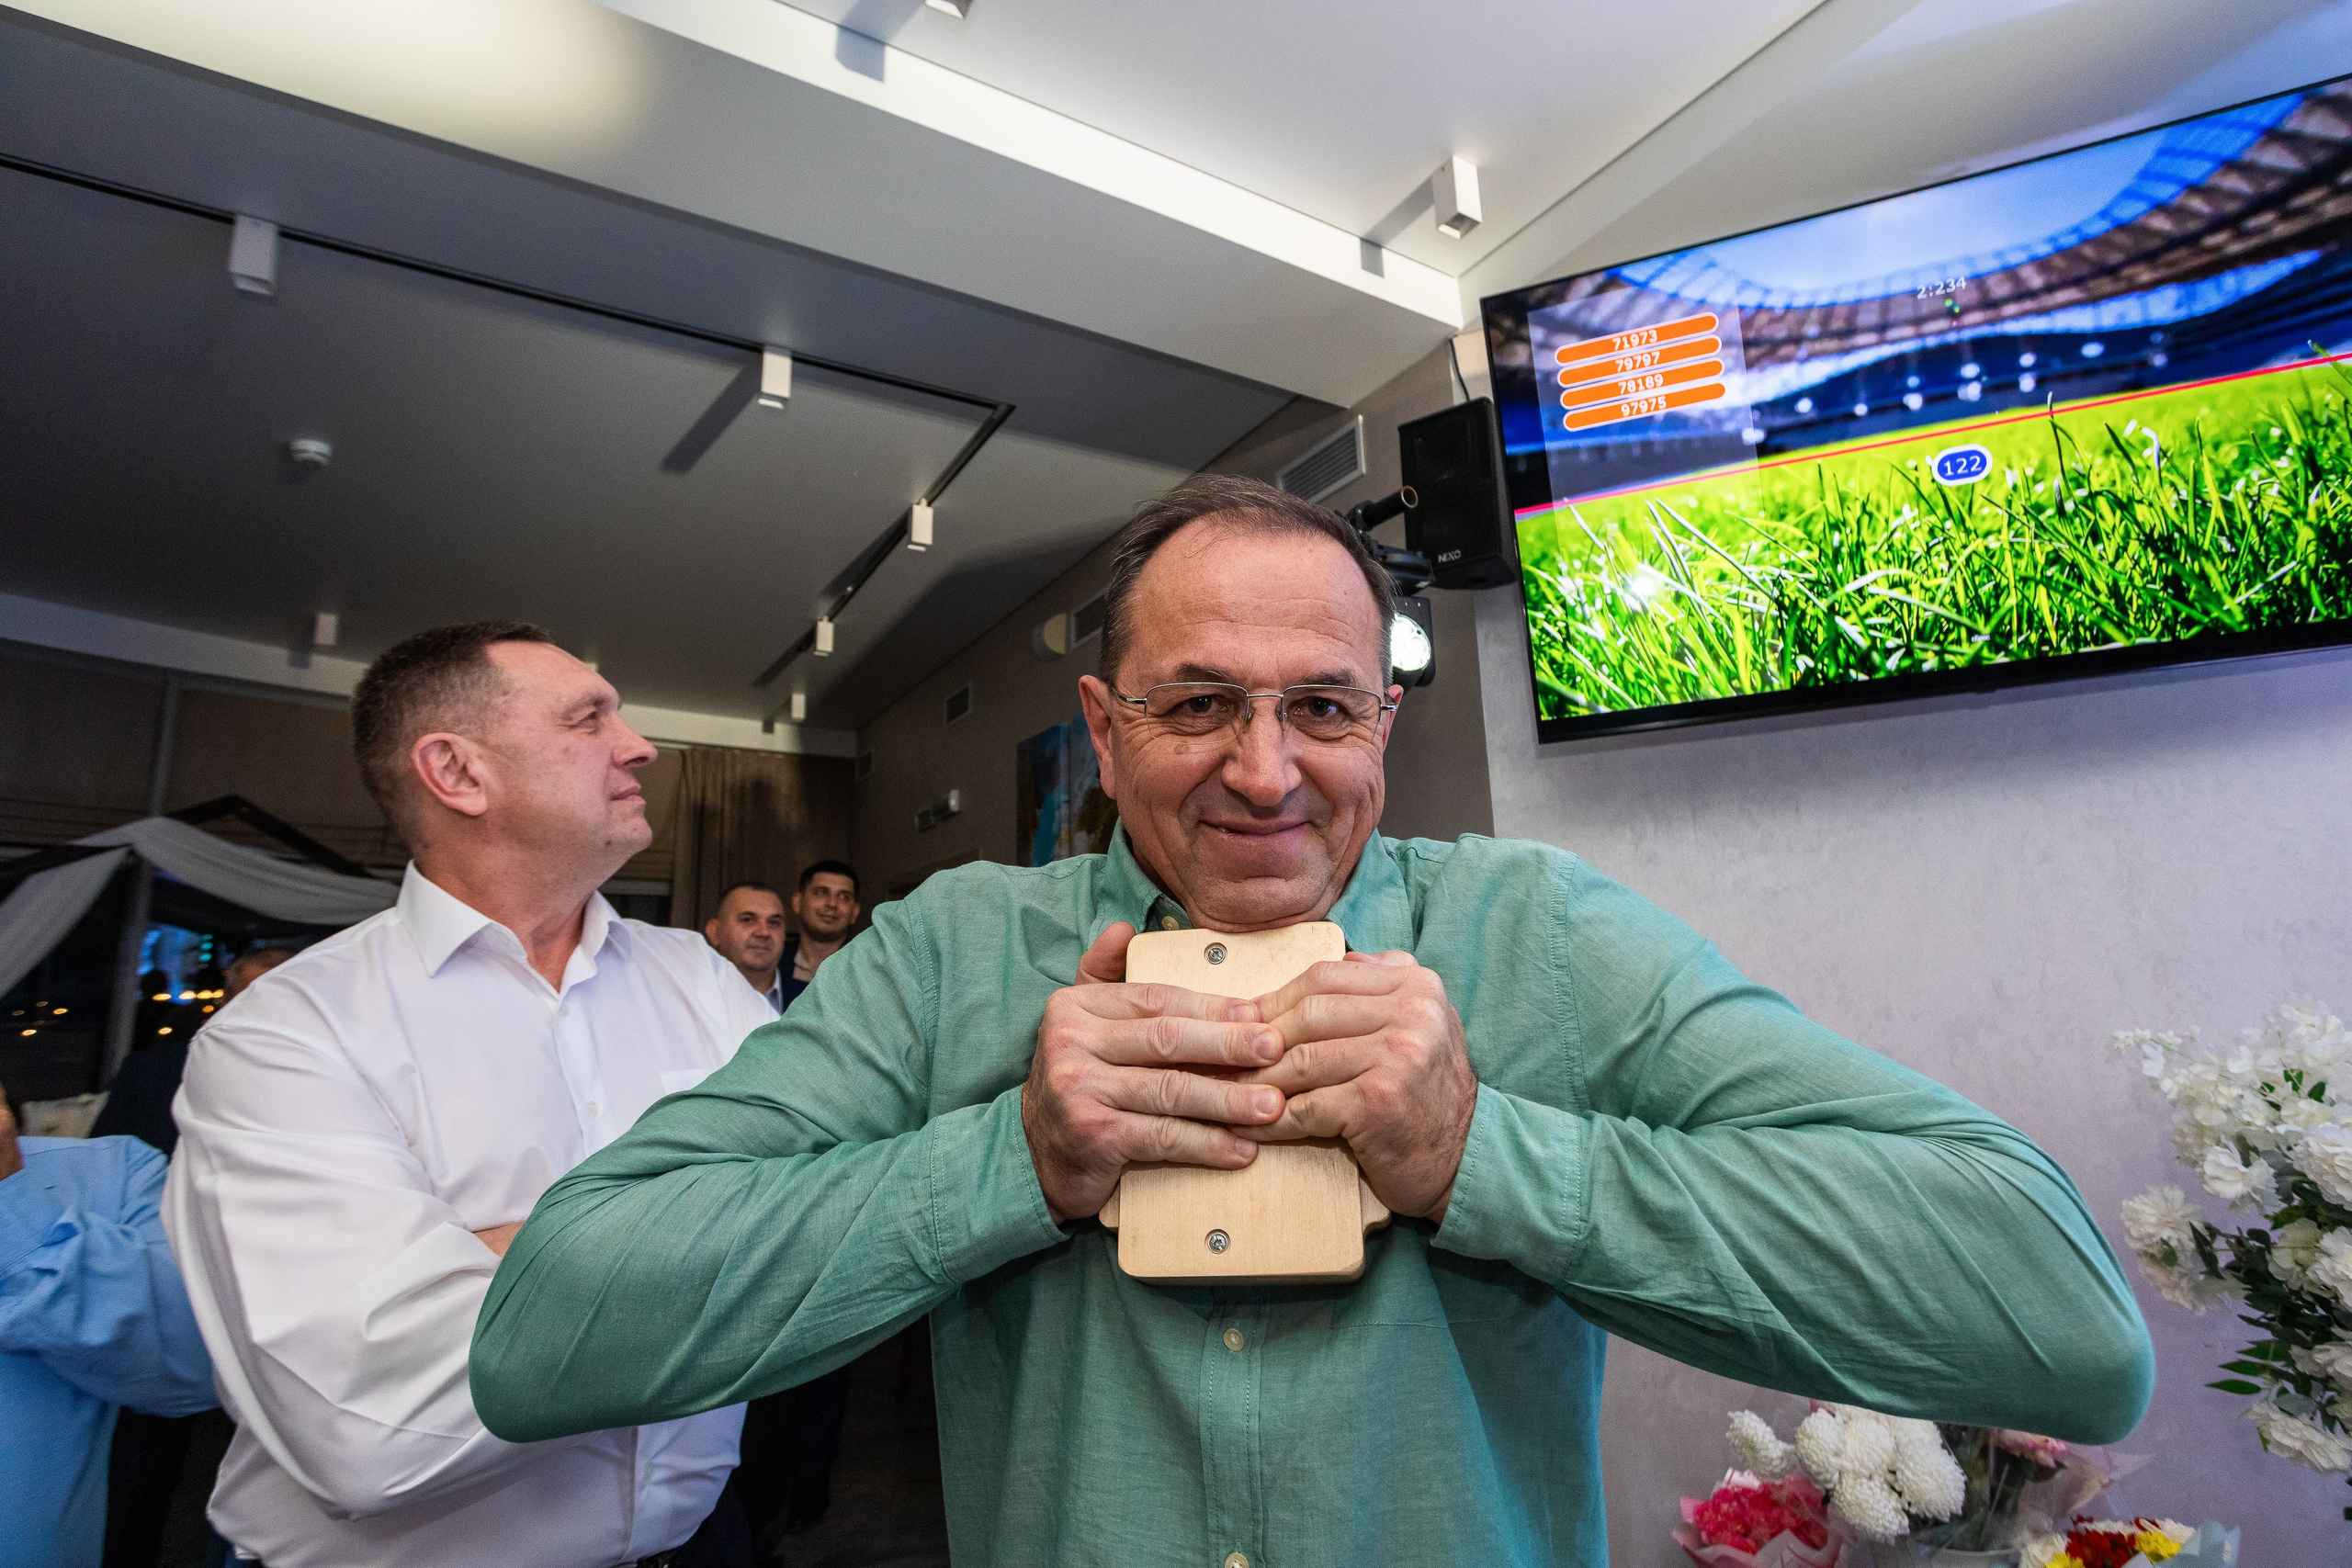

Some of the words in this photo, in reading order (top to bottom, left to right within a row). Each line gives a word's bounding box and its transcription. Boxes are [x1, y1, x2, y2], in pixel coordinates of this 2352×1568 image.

[1917, 276, 1966, 299] 2:234
[1611, 329, 1657, 351] 71973
[1614, 351, 1660, 373] 79797
[1618, 373, 1664, 395] 78189
[1621, 395, 1667, 417] 97975
[1943, 455, 1982, 477] 122
